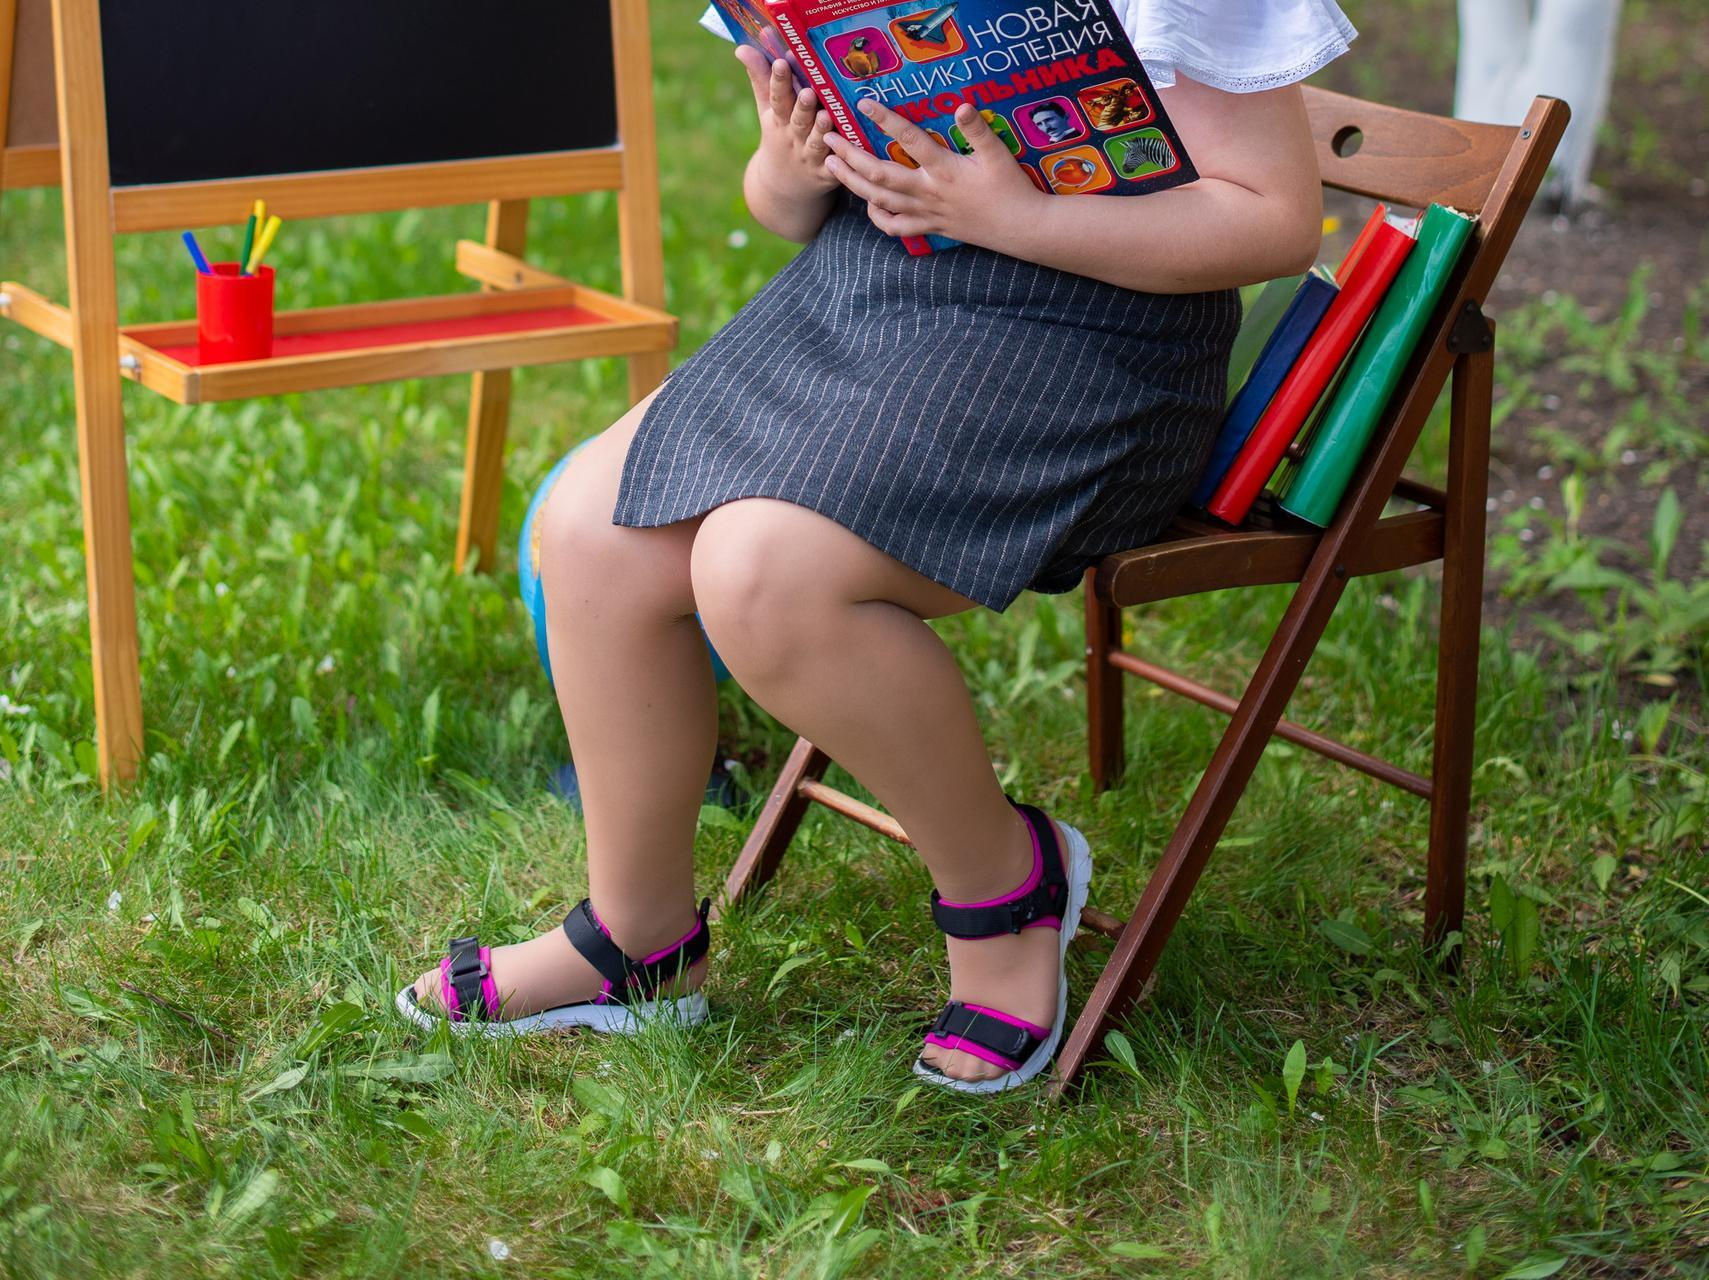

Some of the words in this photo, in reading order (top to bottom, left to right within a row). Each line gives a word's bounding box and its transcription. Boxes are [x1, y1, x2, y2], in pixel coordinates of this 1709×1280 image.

[805, 2, 842, 16] ГЕОГРАФИЯ
[832, 2, 870, 16] ИСКУССТВО
[776, 13, 826, 86] ШКОЛЬНИКА
[854, 21, 1115, 103] ЭНЦИКЛОПЕДИЯ
